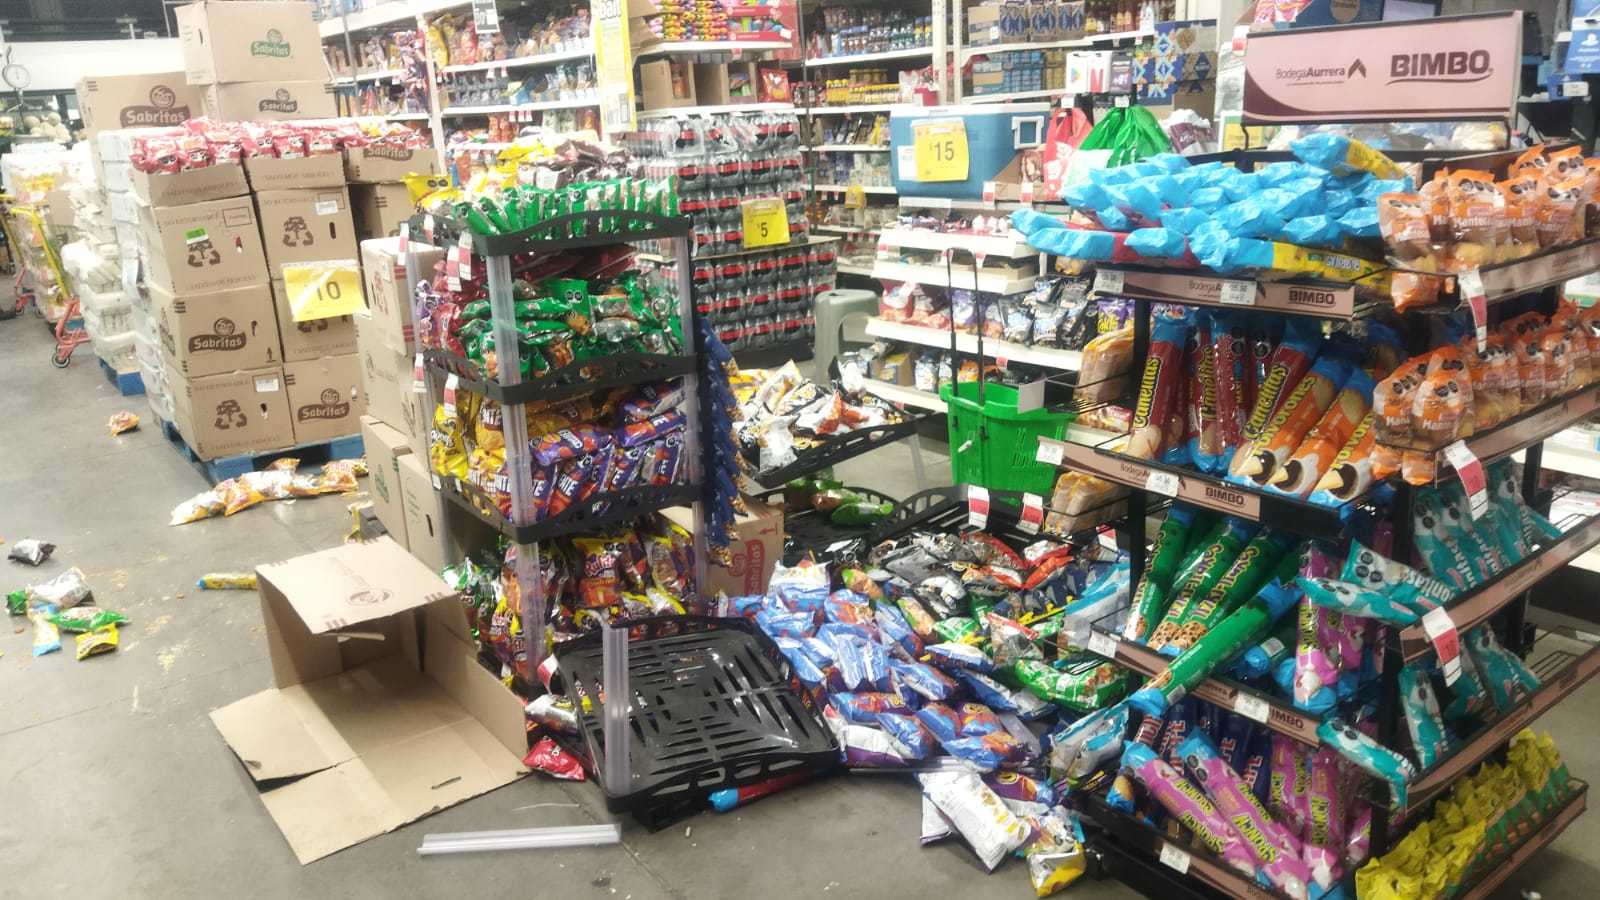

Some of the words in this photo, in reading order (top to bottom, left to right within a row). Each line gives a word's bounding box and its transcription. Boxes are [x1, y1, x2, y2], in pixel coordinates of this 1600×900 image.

[253, 42, 289, 56] Sabritas
[1390, 49, 1491, 77] BIMBO
[126, 110, 186, 124] Sabritas
[262, 101, 296, 112] Sabritas
[1289, 290, 1335, 305] BIMBO
[194, 336, 243, 350] Sabritas
[1133, 356, 1161, 429] Canelitas
[1243, 363, 1287, 440] Canelitas
[302, 405, 347, 419] Sabritas
[1252, 376, 1316, 456] Polvorones
[1330, 410, 1375, 470] Polvoro
[1205, 486, 1246, 506] BIMBO
[1270, 707, 1305, 730] IMBO
[1173, 779, 1215, 816] SPONCH
[1311, 794, 1330, 849] SPONCH
[1232, 813, 1278, 865] SPONCH
